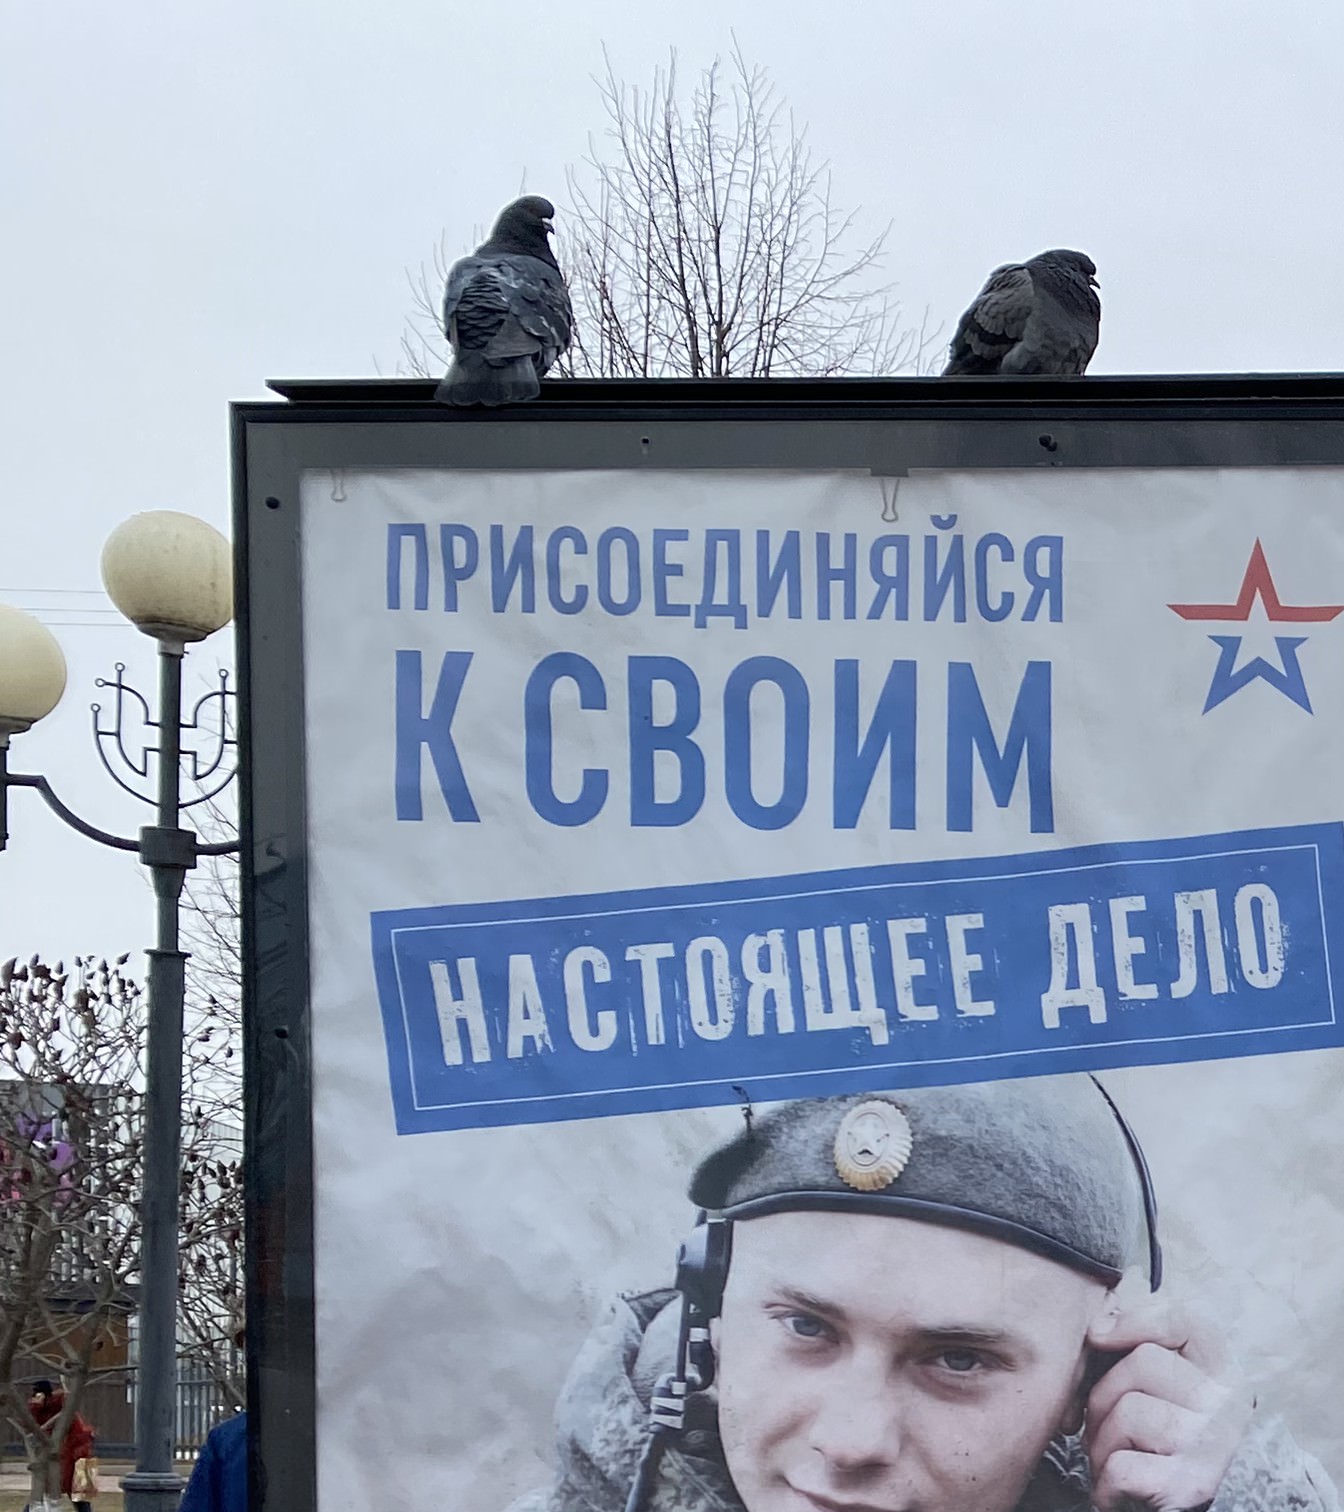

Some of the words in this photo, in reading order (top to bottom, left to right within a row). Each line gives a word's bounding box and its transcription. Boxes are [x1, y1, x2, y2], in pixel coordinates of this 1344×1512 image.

[386, 515, 1064, 629] ПРИСОЕДИНЯЙСЯ
[394, 649, 481, 823] К
[524, 653, 1055, 834] СВОИМ
[426, 911, 996, 1067] НАСТОЯЩЕЕ
[1040, 882, 1285, 1029] ДЕЛО
